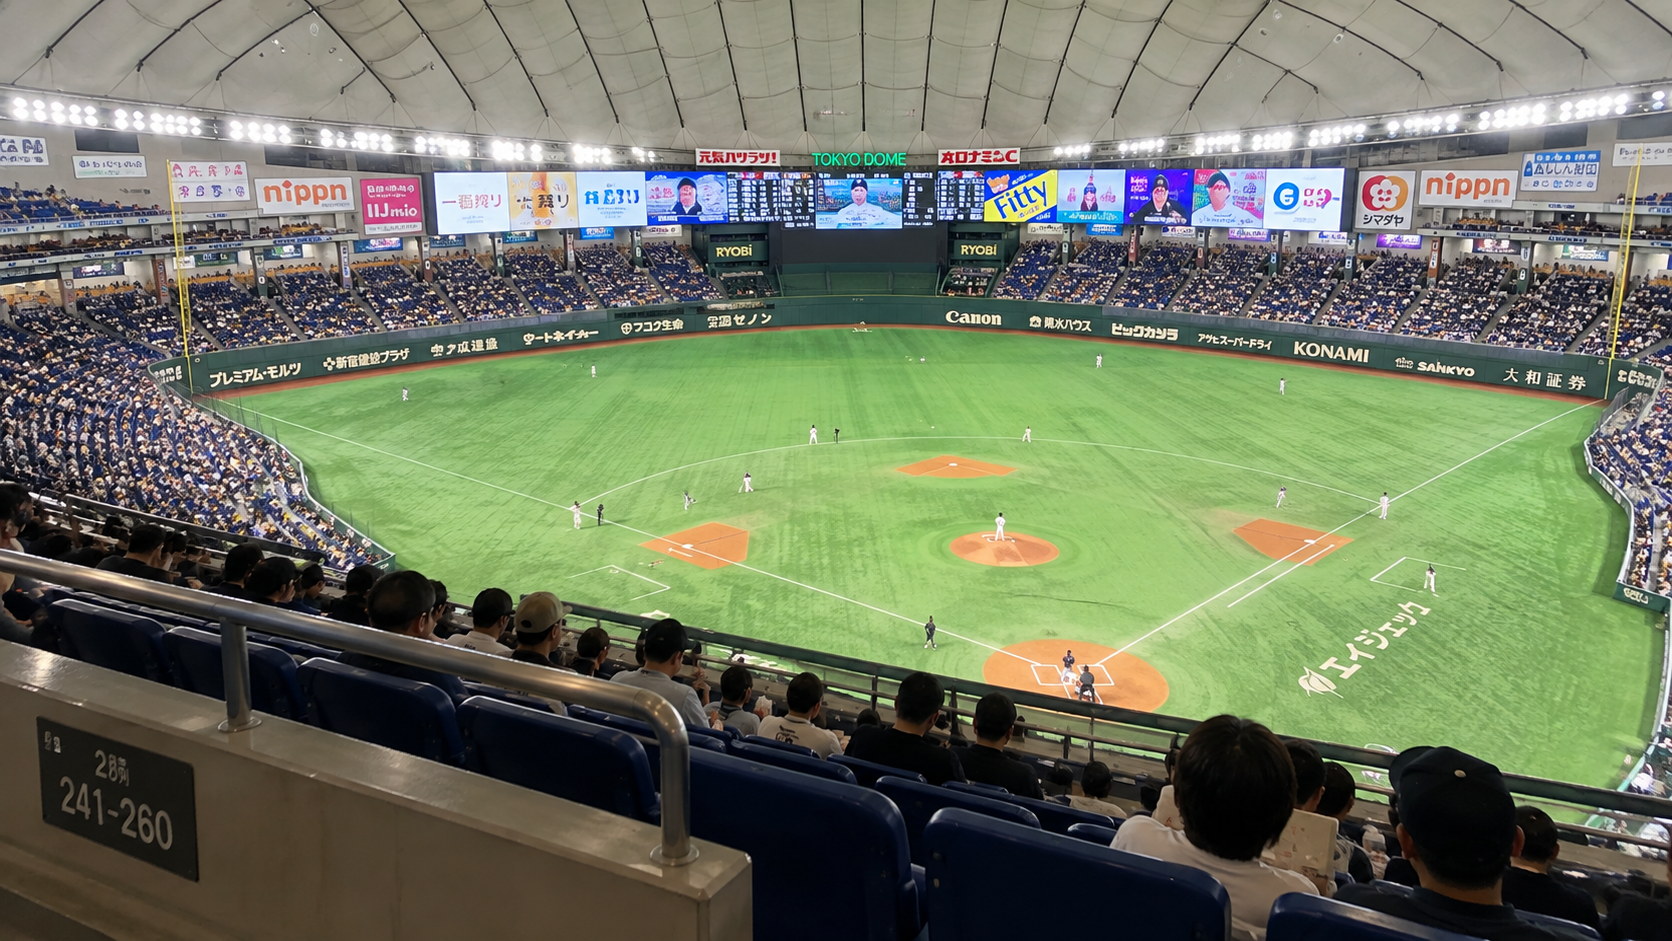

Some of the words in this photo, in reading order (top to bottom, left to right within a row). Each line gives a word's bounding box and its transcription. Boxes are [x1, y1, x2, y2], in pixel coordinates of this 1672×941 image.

[812, 153, 862, 167] TOKYO
[864, 152, 907, 166] DOME
[263, 180, 347, 205] nippn
[1426, 172, 1510, 200] nippn
[994, 181, 1047, 219] Fitty
[1363, 214, 1404, 227] シマダヤ
[945, 310, 1002, 325] Canon
[1294, 341, 1369, 363] KONAMI
[1417, 360, 1476, 377] SANKYO
[1502, 367, 1587, 391] 大和証券
[60, 776, 173, 850] 241-260
